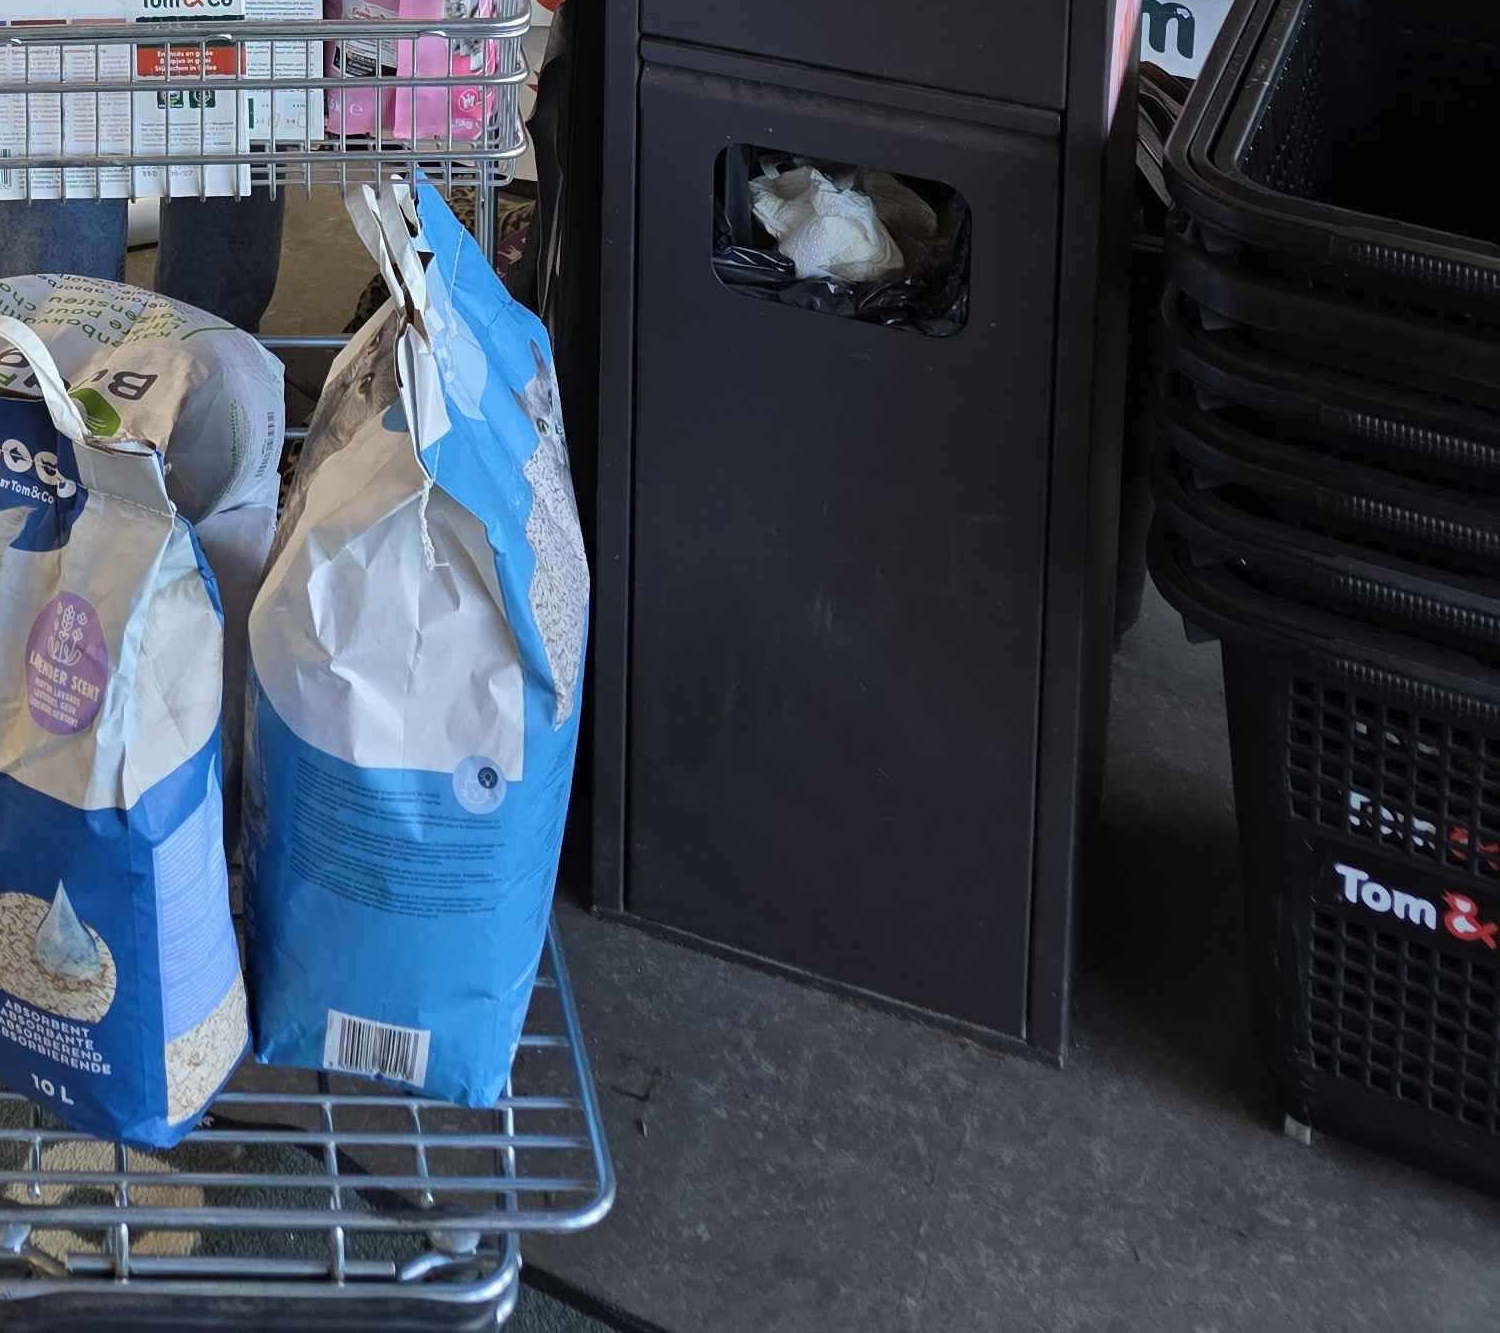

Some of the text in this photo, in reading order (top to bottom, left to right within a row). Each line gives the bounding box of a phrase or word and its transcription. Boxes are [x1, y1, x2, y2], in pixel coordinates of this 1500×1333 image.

[43, 306, 102, 320] pour
[10, 479, 55, 505] Tom&Co
[71, 675, 100, 703] SCENT
[1333, 861, 1498, 951] Tom &
[0, 1008, 95, 1051] ABSORBANTE
[5, 999, 91, 1039] ABSORBENT
[30, 1072, 75, 1106] 10 L
